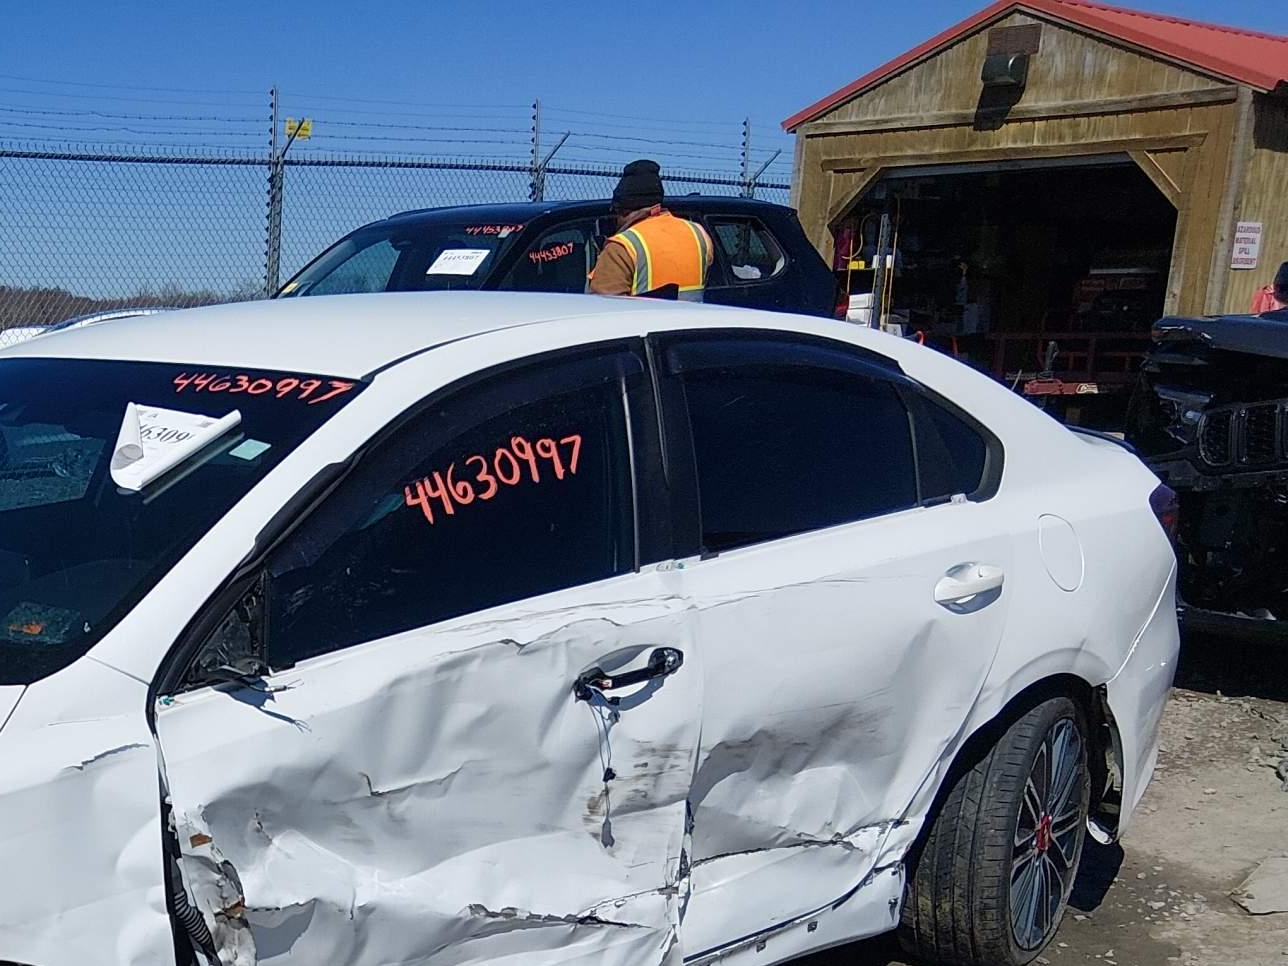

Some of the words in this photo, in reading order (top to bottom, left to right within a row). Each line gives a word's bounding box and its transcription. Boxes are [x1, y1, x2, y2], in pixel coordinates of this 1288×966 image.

[529, 242, 574, 264] 44453807
[174, 372, 355, 405] 44630997
[404, 434, 582, 525] 44630997
